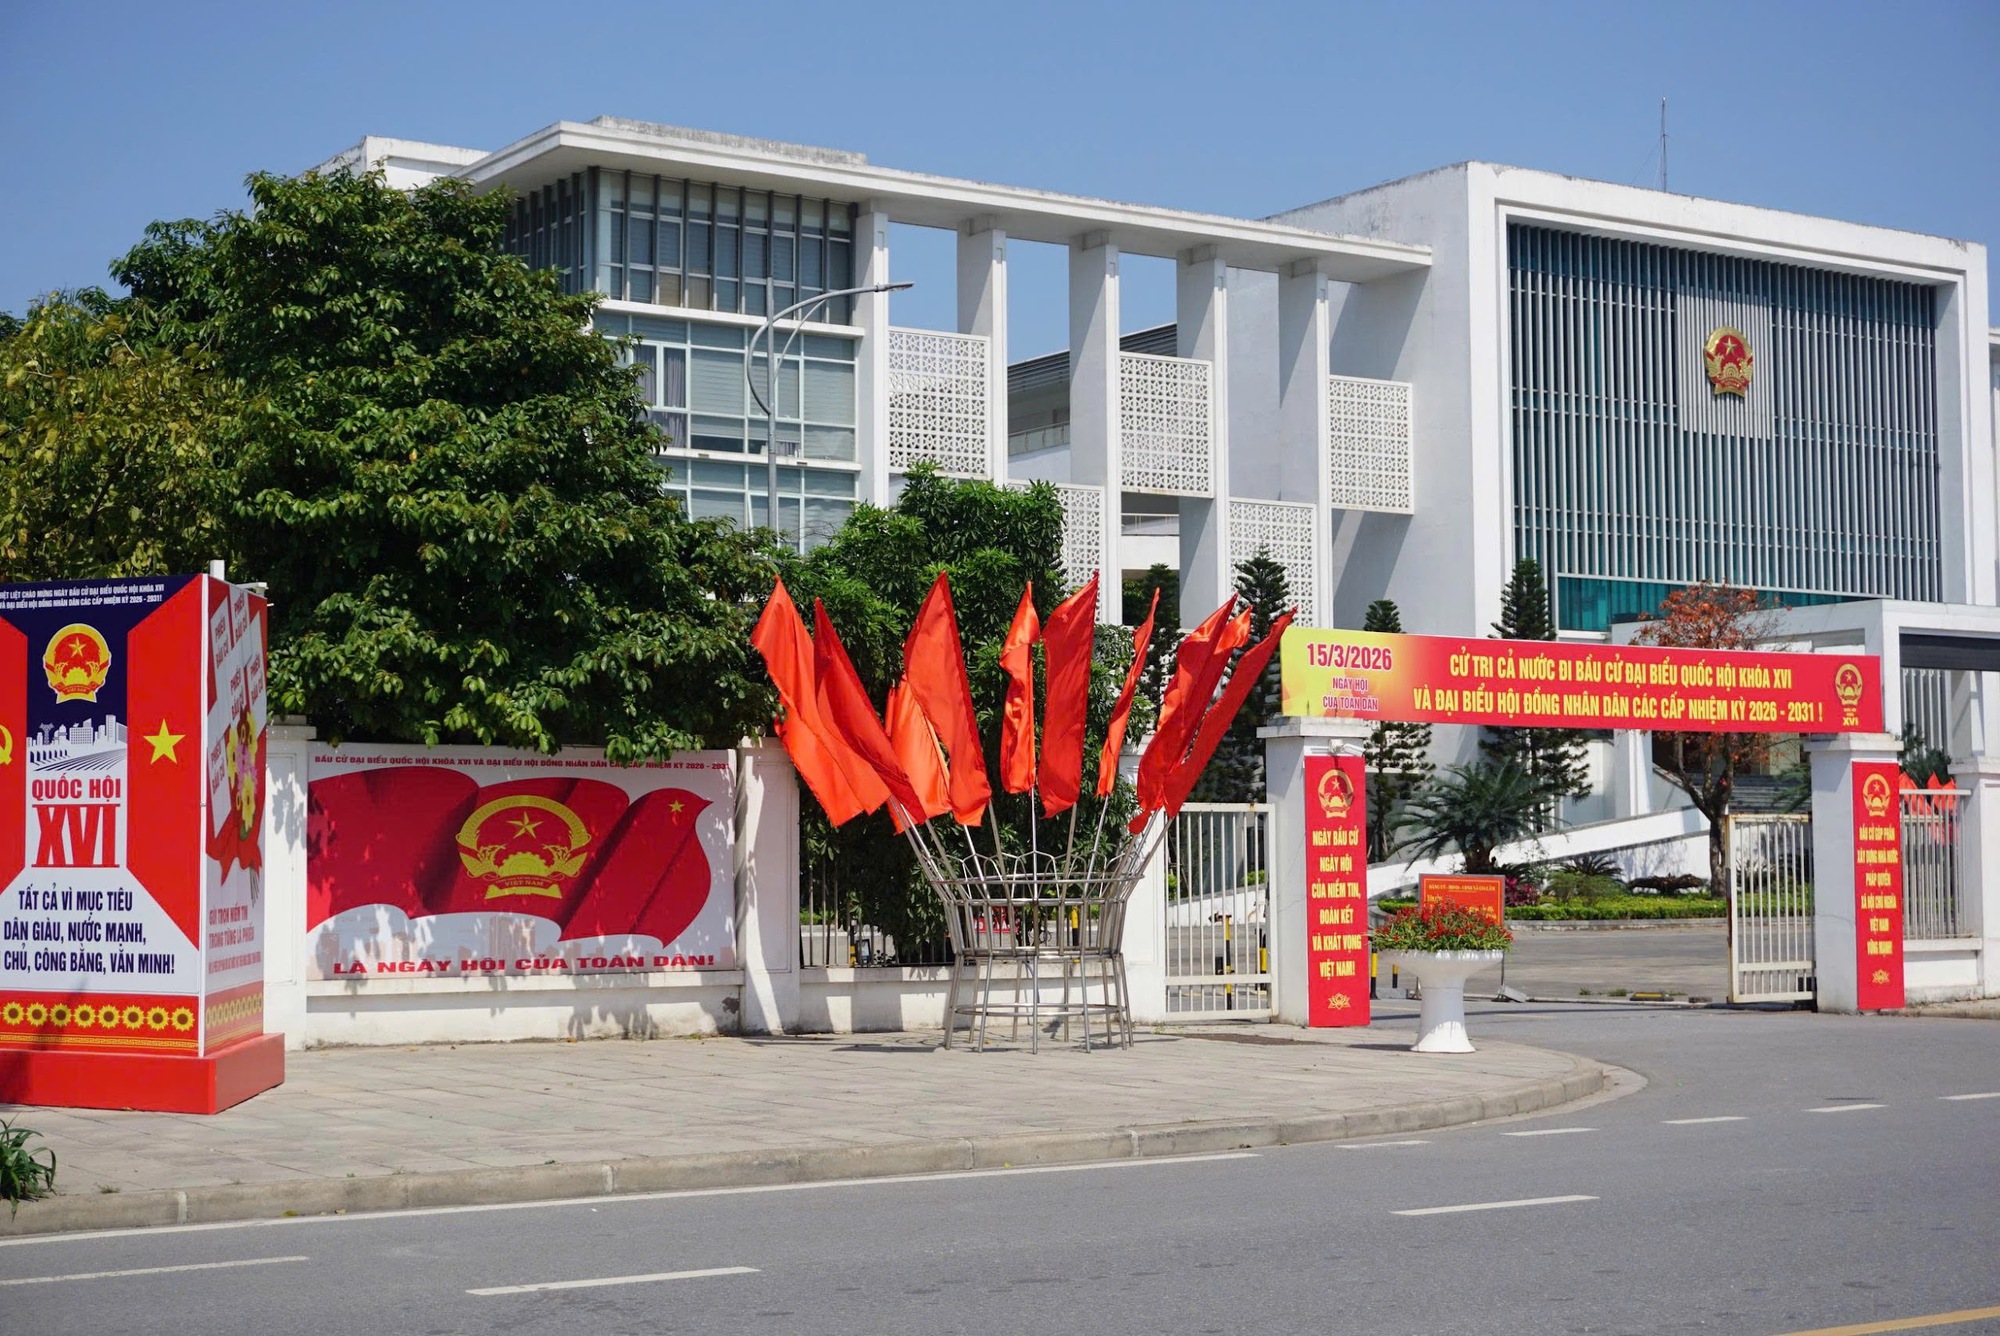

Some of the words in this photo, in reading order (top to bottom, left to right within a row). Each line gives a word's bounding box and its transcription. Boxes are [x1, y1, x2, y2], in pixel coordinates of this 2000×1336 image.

[155, 584, 164, 592] XVI
[1307, 644, 1391, 670] 15/3/2026
[1450, 646, 1470, 676] CỬ
[1472, 656, 1493, 678] TRI
[1497, 648, 1516, 678] CẢ
[1519, 652, 1555, 680] NƯỚC
[1559, 660, 1572, 681] ĐI
[1576, 654, 1601, 682] BẦU
[1605, 653, 1623, 683] CỬ
[1625, 663, 1646, 688] ĐẠI
[1650, 656, 1677, 685] BIỂU
[1681, 659, 1713, 688] QUỐC
[1716, 663, 1736, 691] HỘI
[1739, 664, 1770, 688] KHÓA
[1773, 669, 1792, 688] XVI
[1413, 684, 1432, 710] VÀ
[1435, 689, 1458, 716] ĐẠI
[1463, 683, 1493, 713] BIỂU
[1498, 688, 1519, 718] HỘI
[1524, 686, 1560, 715] ĐỒNG
[1563, 690, 1599, 716] NHÂN
[1603, 692, 1629, 717] DÂN
[1633, 693, 1657, 718] CÁC
[1661, 691, 1685, 718] CẤP
[1689, 695, 1728, 724] NHIỆM
[1731, 696, 1746, 720] KỲ
[1749, 701, 1777, 721] 2026
[1788, 702, 1814, 722] 2031
[1843, 717, 1858, 726] XVI
[32, 772, 82, 802] QUỐC
[89, 774, 121, 802] HỘI
[32, 804, 120, 868] XVI
[1312, 827, 1331, 846] NGÀY
[1320, 853, 1338, 872] NGÀY
[19, 884, 39, 910] TẤT
[42, 883, 58, 910] CẢ
[62, 886, 72, 910] VÌ
[76, 891, 103, 915] MỤC
[107, 888, 133, 911] TIÊU
[4, 917, 28, 941] DÂN
[32, 917, 64, 943] GIÀU,
[68, 916, 101, 942] NƯỚC
[106, 922, 146, 946] MẠNH,
[1312, 932, 1322, 951] VÀ
[4, 943, 30, 973] CHỦ,
[34, 947, 66, 972] CÔNG
[70, 943, 106, 974] BẰNG,
[110, 948, 134, 973] VĂN
[138, 954, 175, 974] MINH!
[334, 960, 367, 974] LÀ
[378, 959, 451, 972] NGÀY
[461, 958, 505, 972] HỘI
[515, 954, 568, 970] CỦA
[577, 955, 644, 968] TOÀN
[654, 953, 714, 967] DÂN!
[1320, 958, 1334, 980] VIỆT
